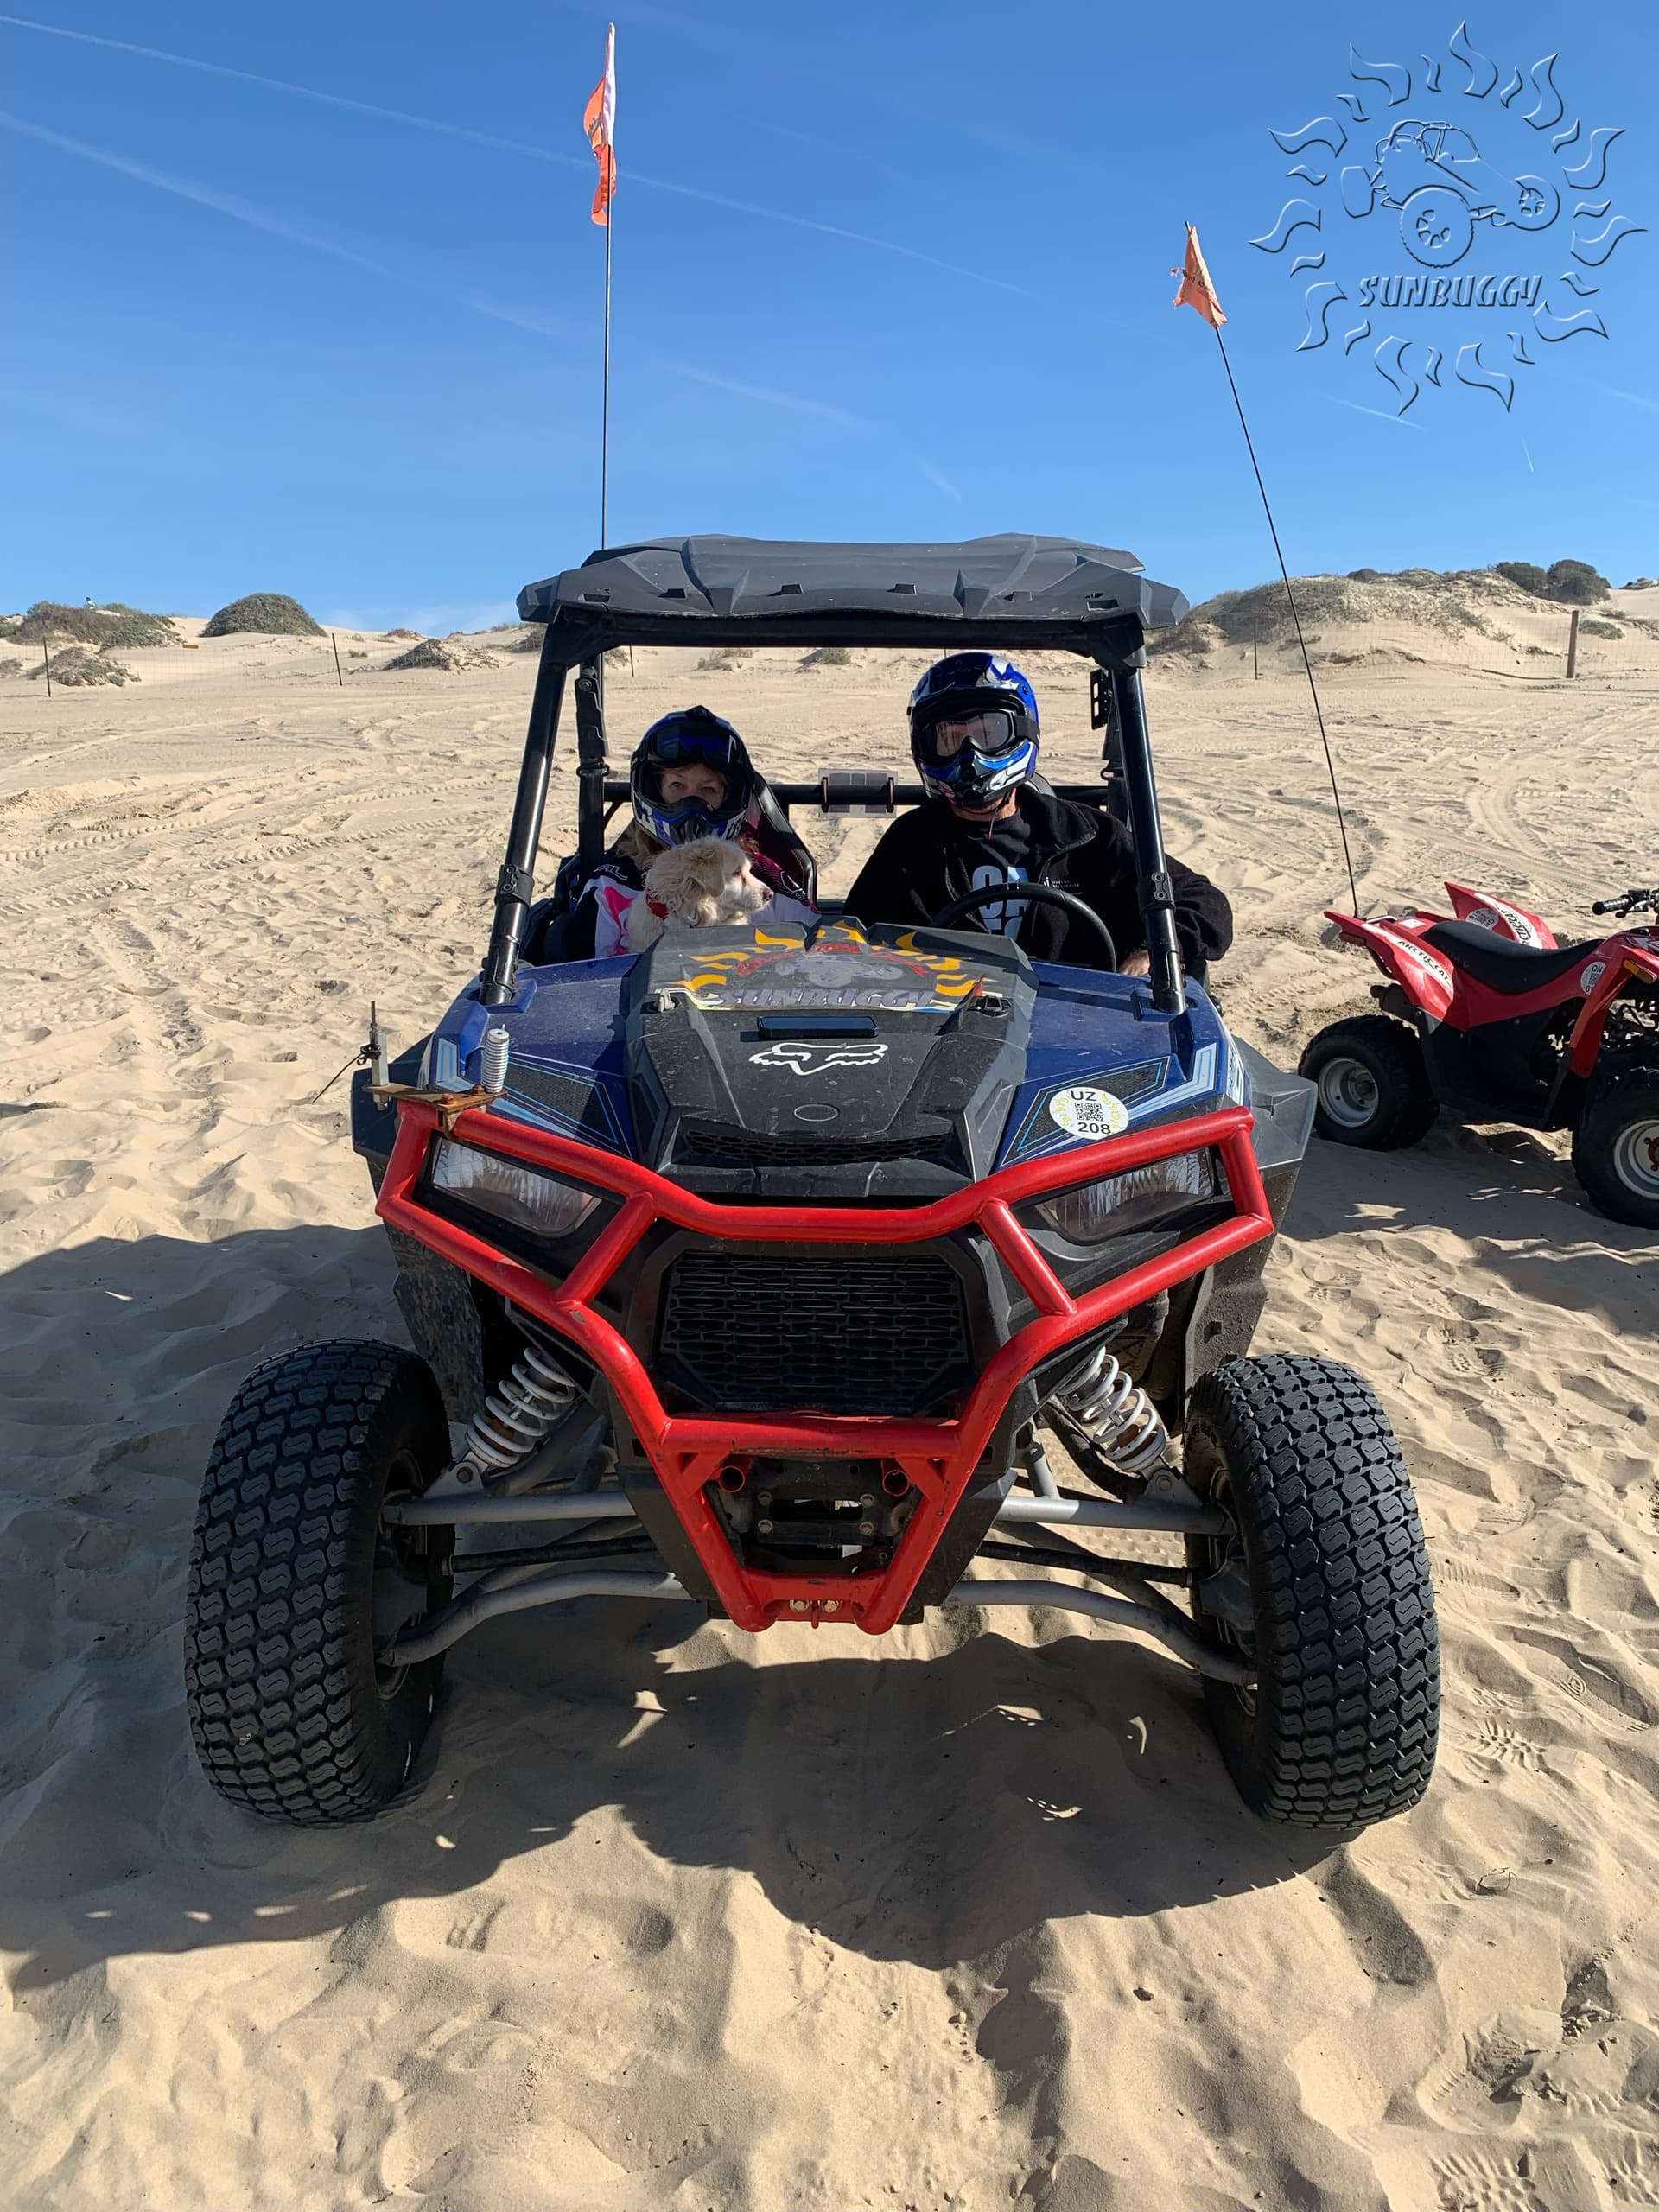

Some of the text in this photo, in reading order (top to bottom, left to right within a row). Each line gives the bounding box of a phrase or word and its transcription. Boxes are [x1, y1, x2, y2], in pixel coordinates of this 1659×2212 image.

[1397, 940, 1448, 980] ARCTIC CAT
[721, 988, 935, 1007] SUNBUGGY
[1071, 1090, 1097, 1102] UZ
[1077, 1122, 1111, 1135] 208
